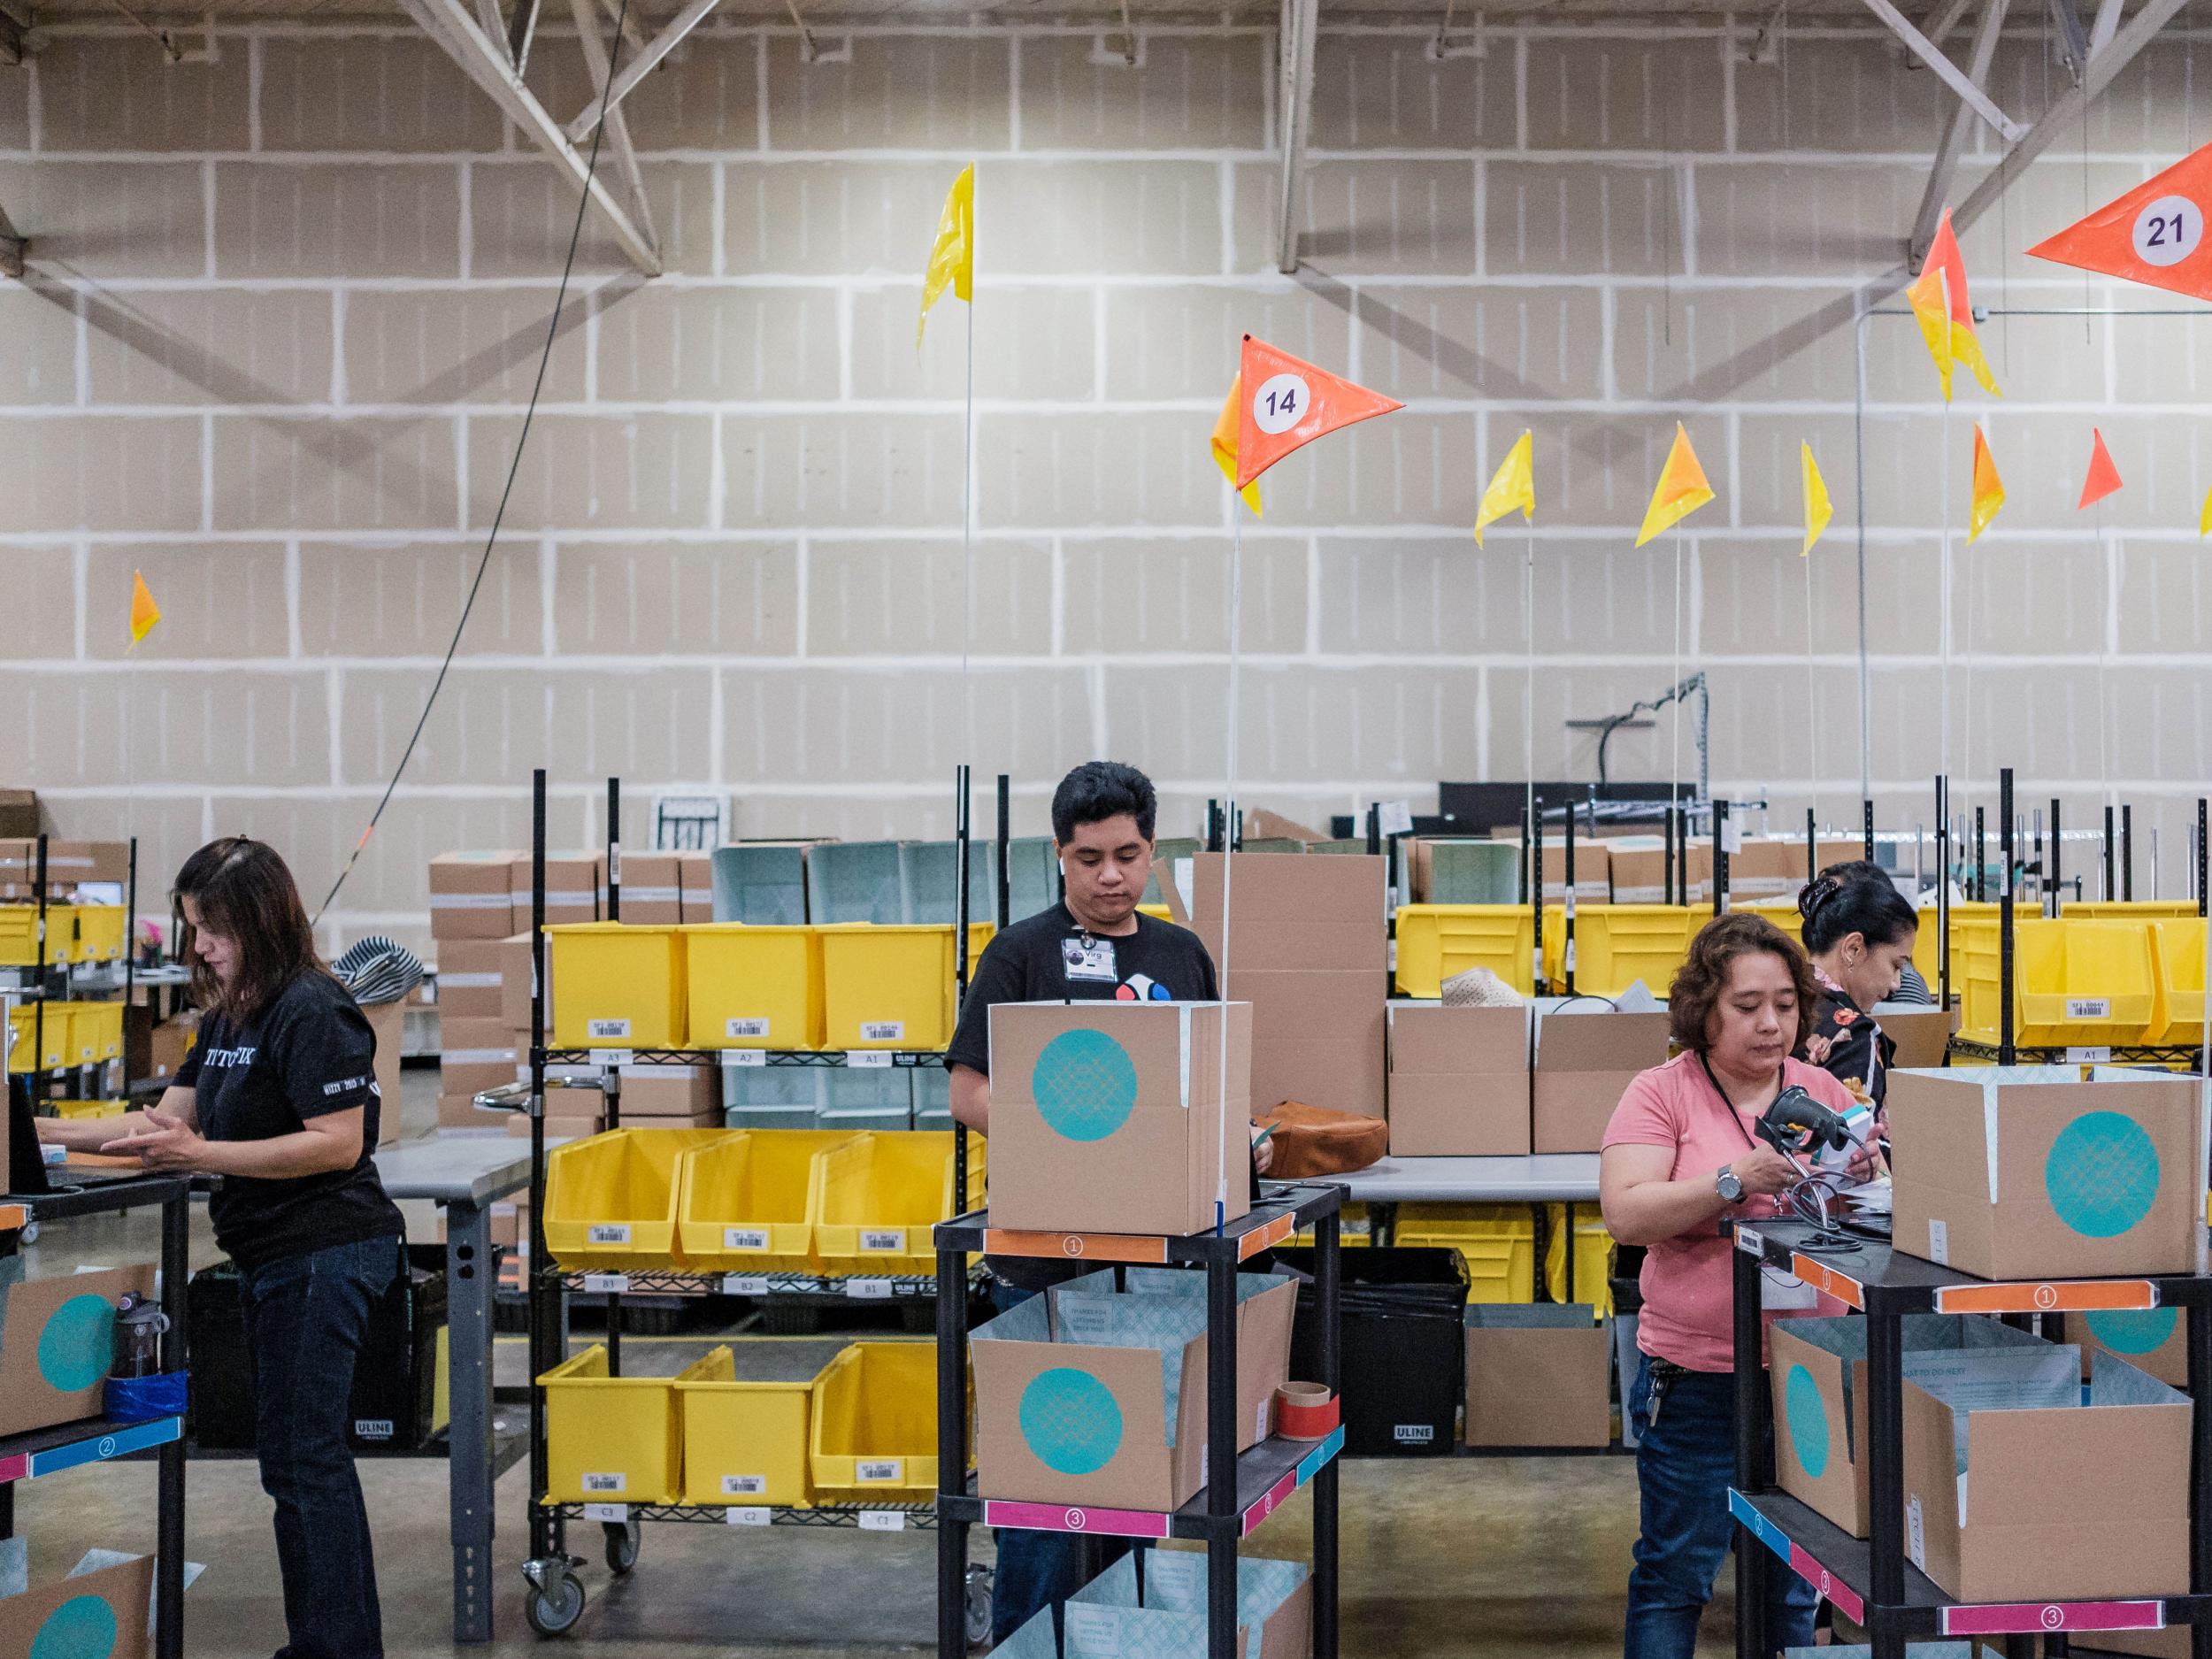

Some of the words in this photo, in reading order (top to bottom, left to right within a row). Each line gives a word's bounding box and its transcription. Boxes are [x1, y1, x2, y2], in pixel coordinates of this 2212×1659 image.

[2147, 212, 2183, 247] 21
[1265, 388, 1296, 416] 14
[1085, 949, 1102, 960] Virg
[607, 1054, 619, 1063] A3
[740, 1054, 752, 1063] A2
[865, 1055, 878, 1064] A1
[2084, 1051, 2096, 1060] A1
[741, 1282, 753, 1291] B2
[864, 1284, 877, 1294] B1
[357, 1422, 391, 1432] ULINE
[1396, 1427, 1431, 1438] ULINE
[744, 1511, 757, 1521] C2
[877, 1516, 889, 1525] C1
